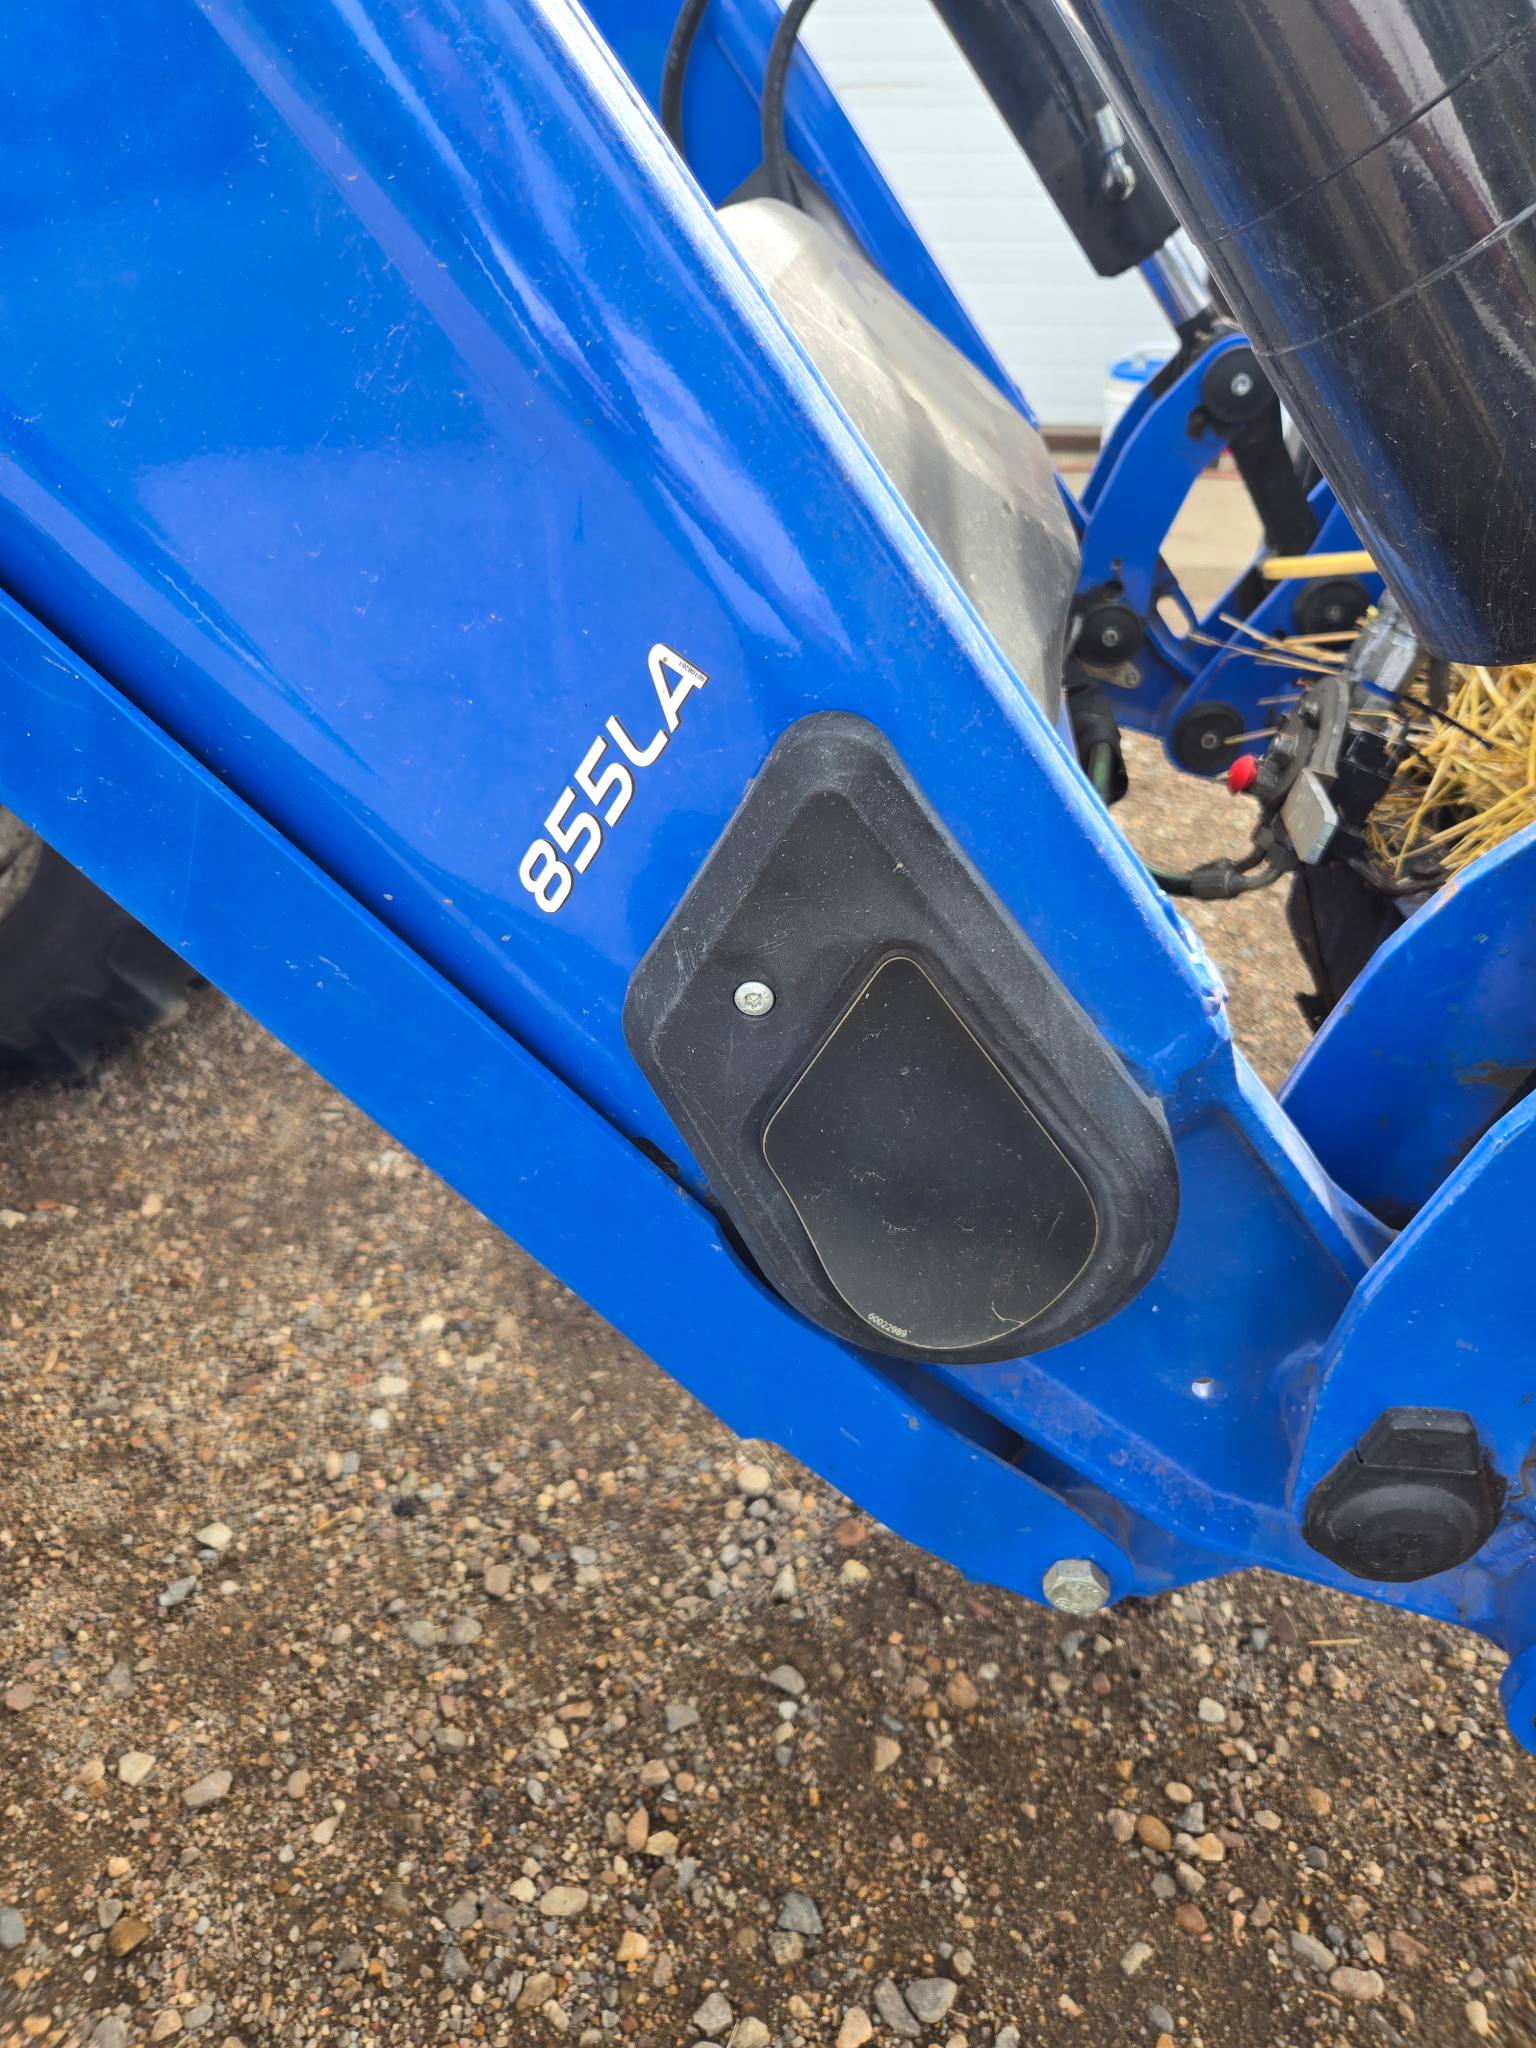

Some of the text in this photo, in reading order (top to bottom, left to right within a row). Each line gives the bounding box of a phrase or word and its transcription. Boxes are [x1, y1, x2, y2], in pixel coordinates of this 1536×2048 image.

[678, 660, 706, 682] 60108261
[519, 643, 710, 913] 855LA
[868, 1312, 908, 1338] 60022989
